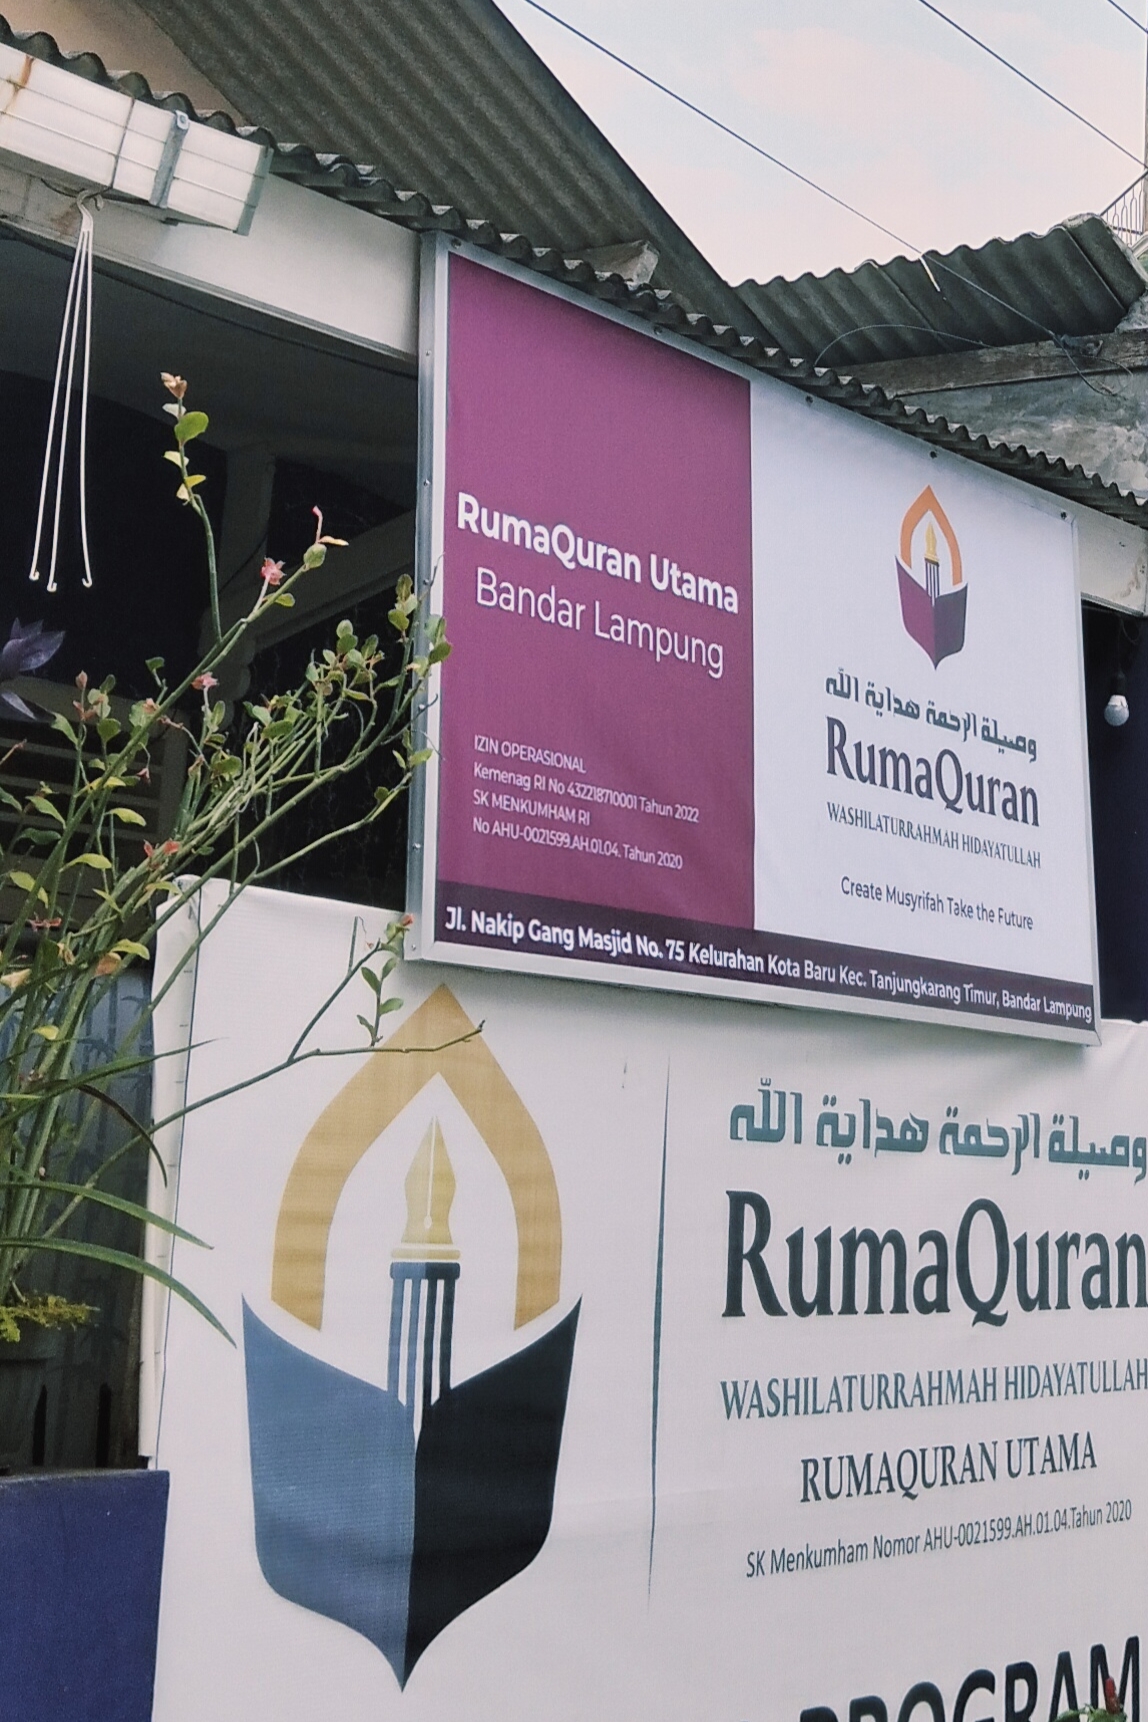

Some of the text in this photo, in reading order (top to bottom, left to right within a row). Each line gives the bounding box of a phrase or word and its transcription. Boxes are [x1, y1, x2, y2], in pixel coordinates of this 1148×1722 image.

[457, 491, 739, 614] RumaQuran Utama
[476, 567, 724, 678] Bandar Lampung
[865, 681, 920, 719] هداية
[926, 700, 977, 742] الرحمة
[474, 734, 586, 774] IZIN OPERASIONAL
[825, 715, 1040, 827] RumaQuran
[473, 762, 531, 791] Kemenag
[533, 775, 546, 790] RI
[548, 778, 565, 795] No
[639, 796, 673, 817] Tahun
[674, 804, 699, 823] 2022
[473, 789, 590, 827] SK MENKUMHAM RI
[473, 817, 490, 835] No
[622, 844, 656, 864] Tahun
[657, 851, 684, 870] 2020
[826, 801, 1042, 869] WASHILATURRAHMAH HIDAYATULLAH
[841, 876, 1034, 930] Create Musyrifah Take the Future
[445, 906, 1093, 1023] Jl. Nakip Gang Masjid No. 75 Kelurahan Kota Baru Kec. Tanjungkarang Timur, Bandar Lampung
[815, 1094, 929, 1165] هداية
[939, 1105, 1041, 1176] الرحمة
[720, 1365, 998, 1420] WASHILATURRAHMAH
[800, 1430, 1098, 1503] RUMAQURAN UTAMA
[746, 1551, 766, 1578] SK
[770, 1539, 869, 1574] Menkumham
[873, 1534, 921, 1560] Nomor
[1106, 1498, 1132, 1524] 2020
[799, 1635, 1140, 1722] GRAM
